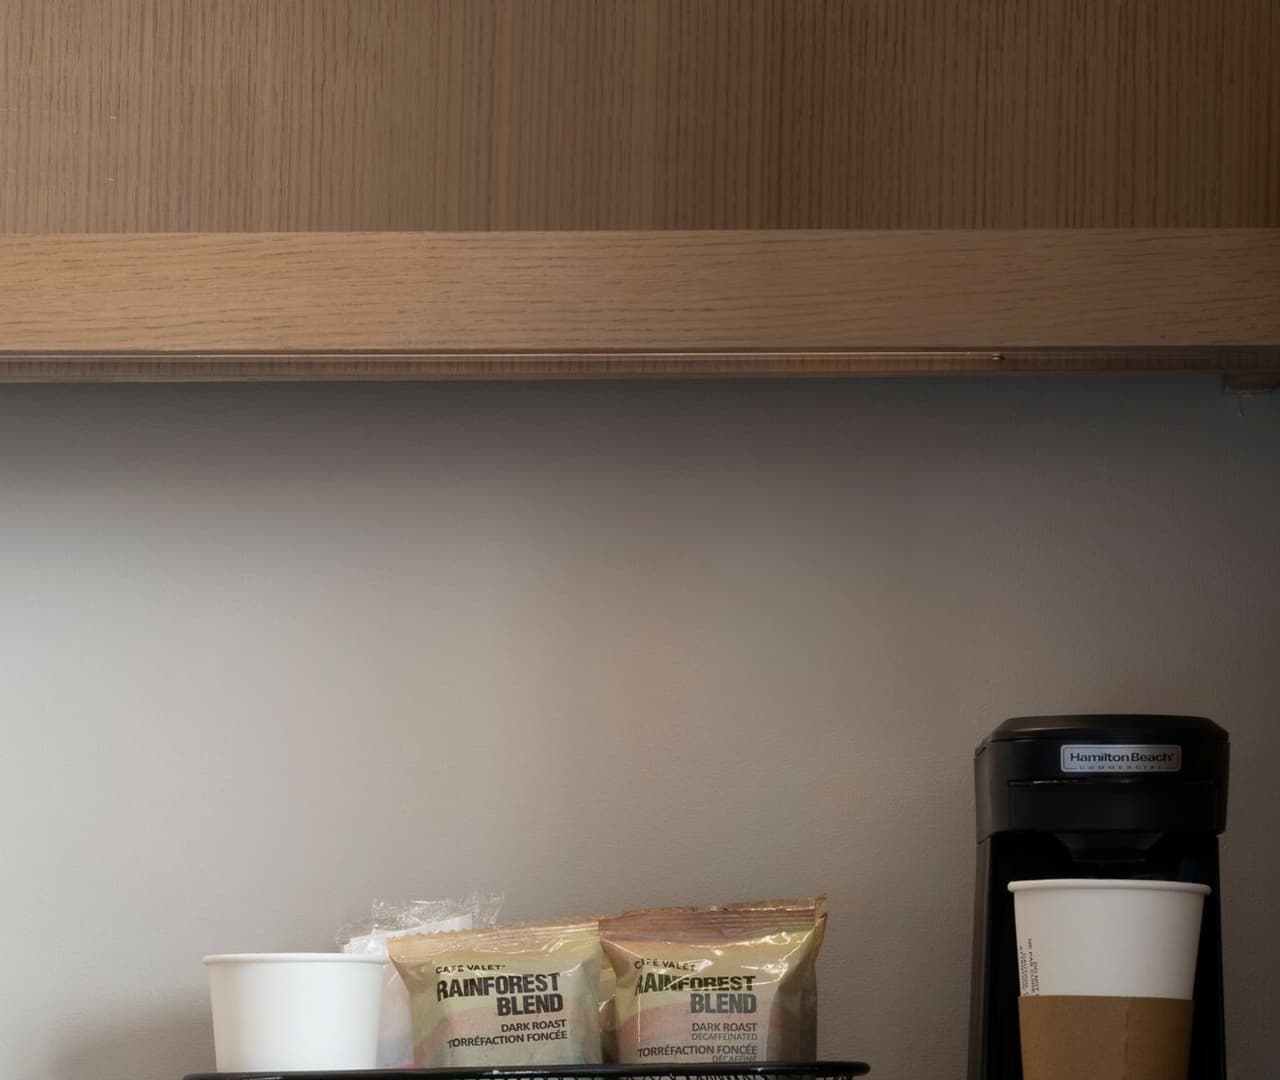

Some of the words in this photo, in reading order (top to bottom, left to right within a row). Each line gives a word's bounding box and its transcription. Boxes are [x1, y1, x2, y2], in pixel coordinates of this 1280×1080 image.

[1070, 752, 1130, 762] Hamilton
[437, 972, 560, 1001] RAINFOREST
[496, 993, 564, 1016] BLEND
[690, 993, 757, 1014] BLEND
[501, 1022, 530, 1033] DARK
[532, 1019, 567, 1030] ROAST
[691, 1022, 721, 1032] DARK
[723, 1022, 758, 1032] ROAST
[448, 1034, 525, 1049] TORRÉFACTION
[526, 1030, 568, 1042] FONCÉE
[691, 1033, 758, 1041] DECAFFEINATED
[638, 1044, 715, 1058] TORRÉFACTION
[717, 1043, 758, 1055] FONCÉE
